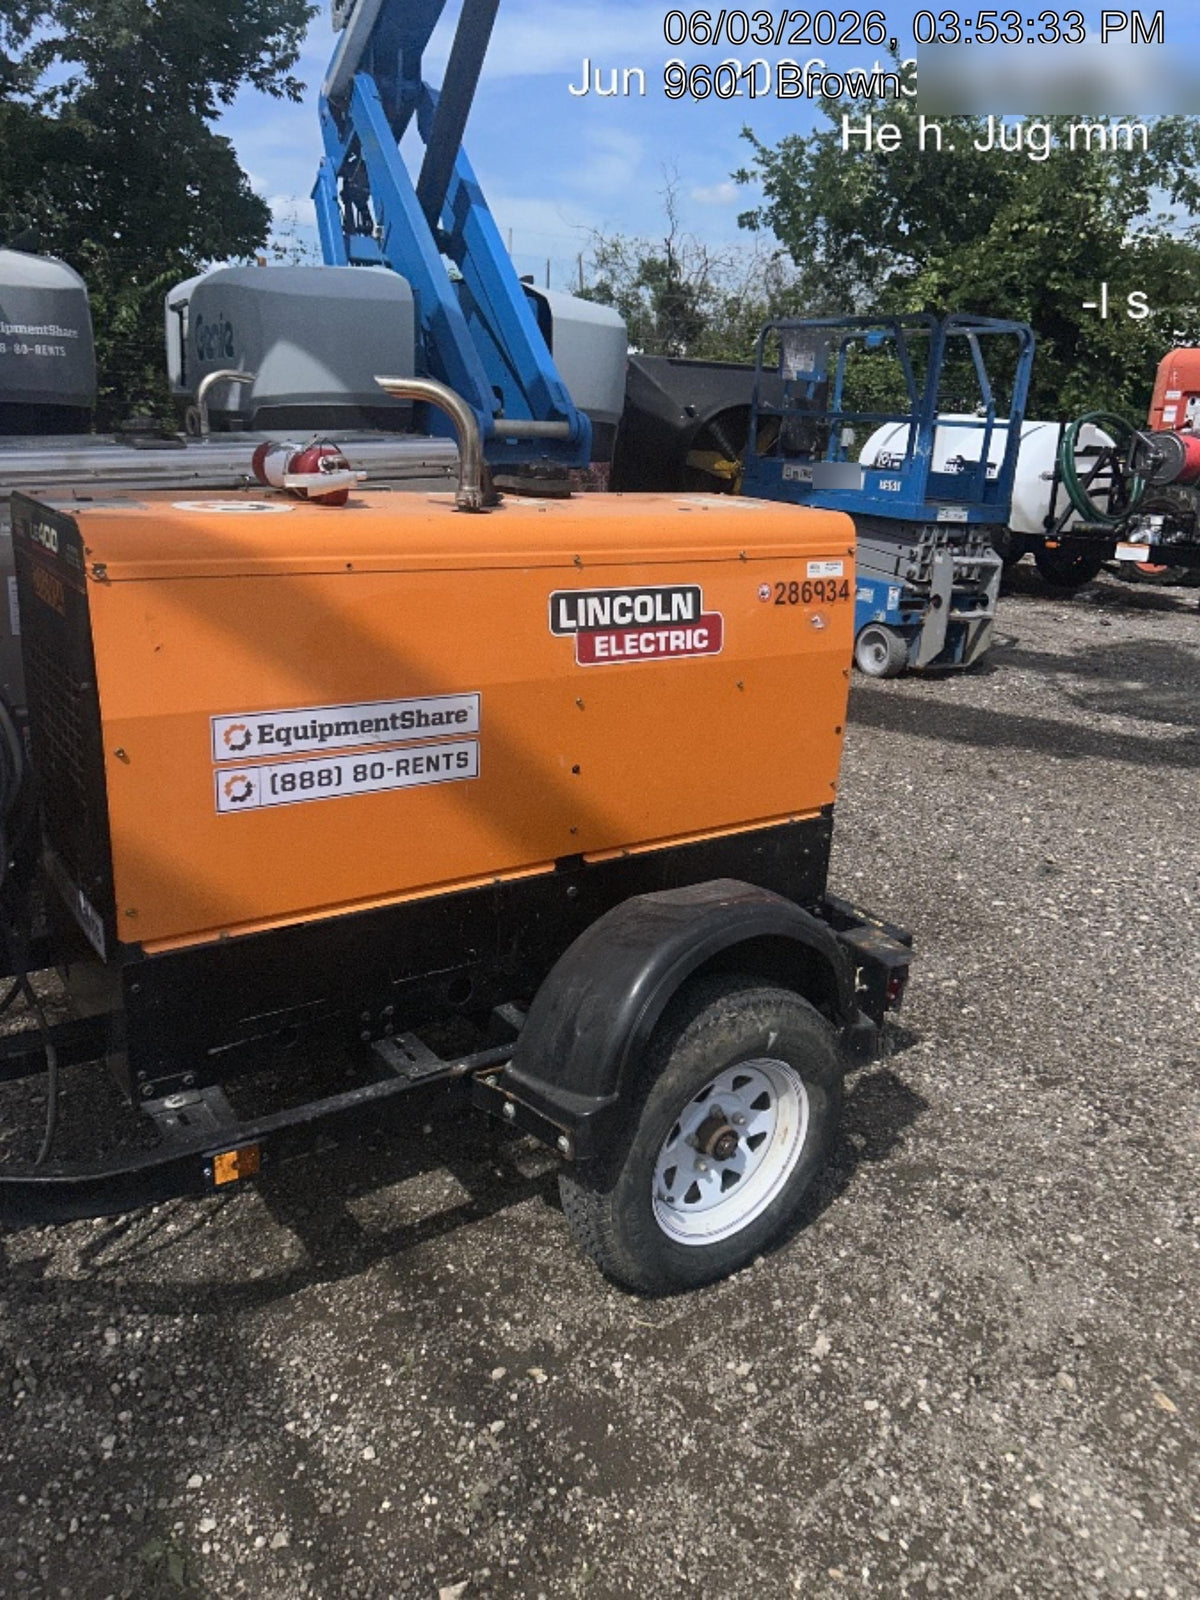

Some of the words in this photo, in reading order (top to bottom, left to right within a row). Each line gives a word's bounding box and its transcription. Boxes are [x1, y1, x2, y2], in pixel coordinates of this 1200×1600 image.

[559, 592, 694, 628] LINCOLN
[774, 579, 850, 605] 286934
[594, 628, 709, 657] ELECTRIC
[257, 708, 469, 747] EquipmentShare
[270, 766, 342, 795] (888)
[353, 751, 469, 783] 80-RENTS
